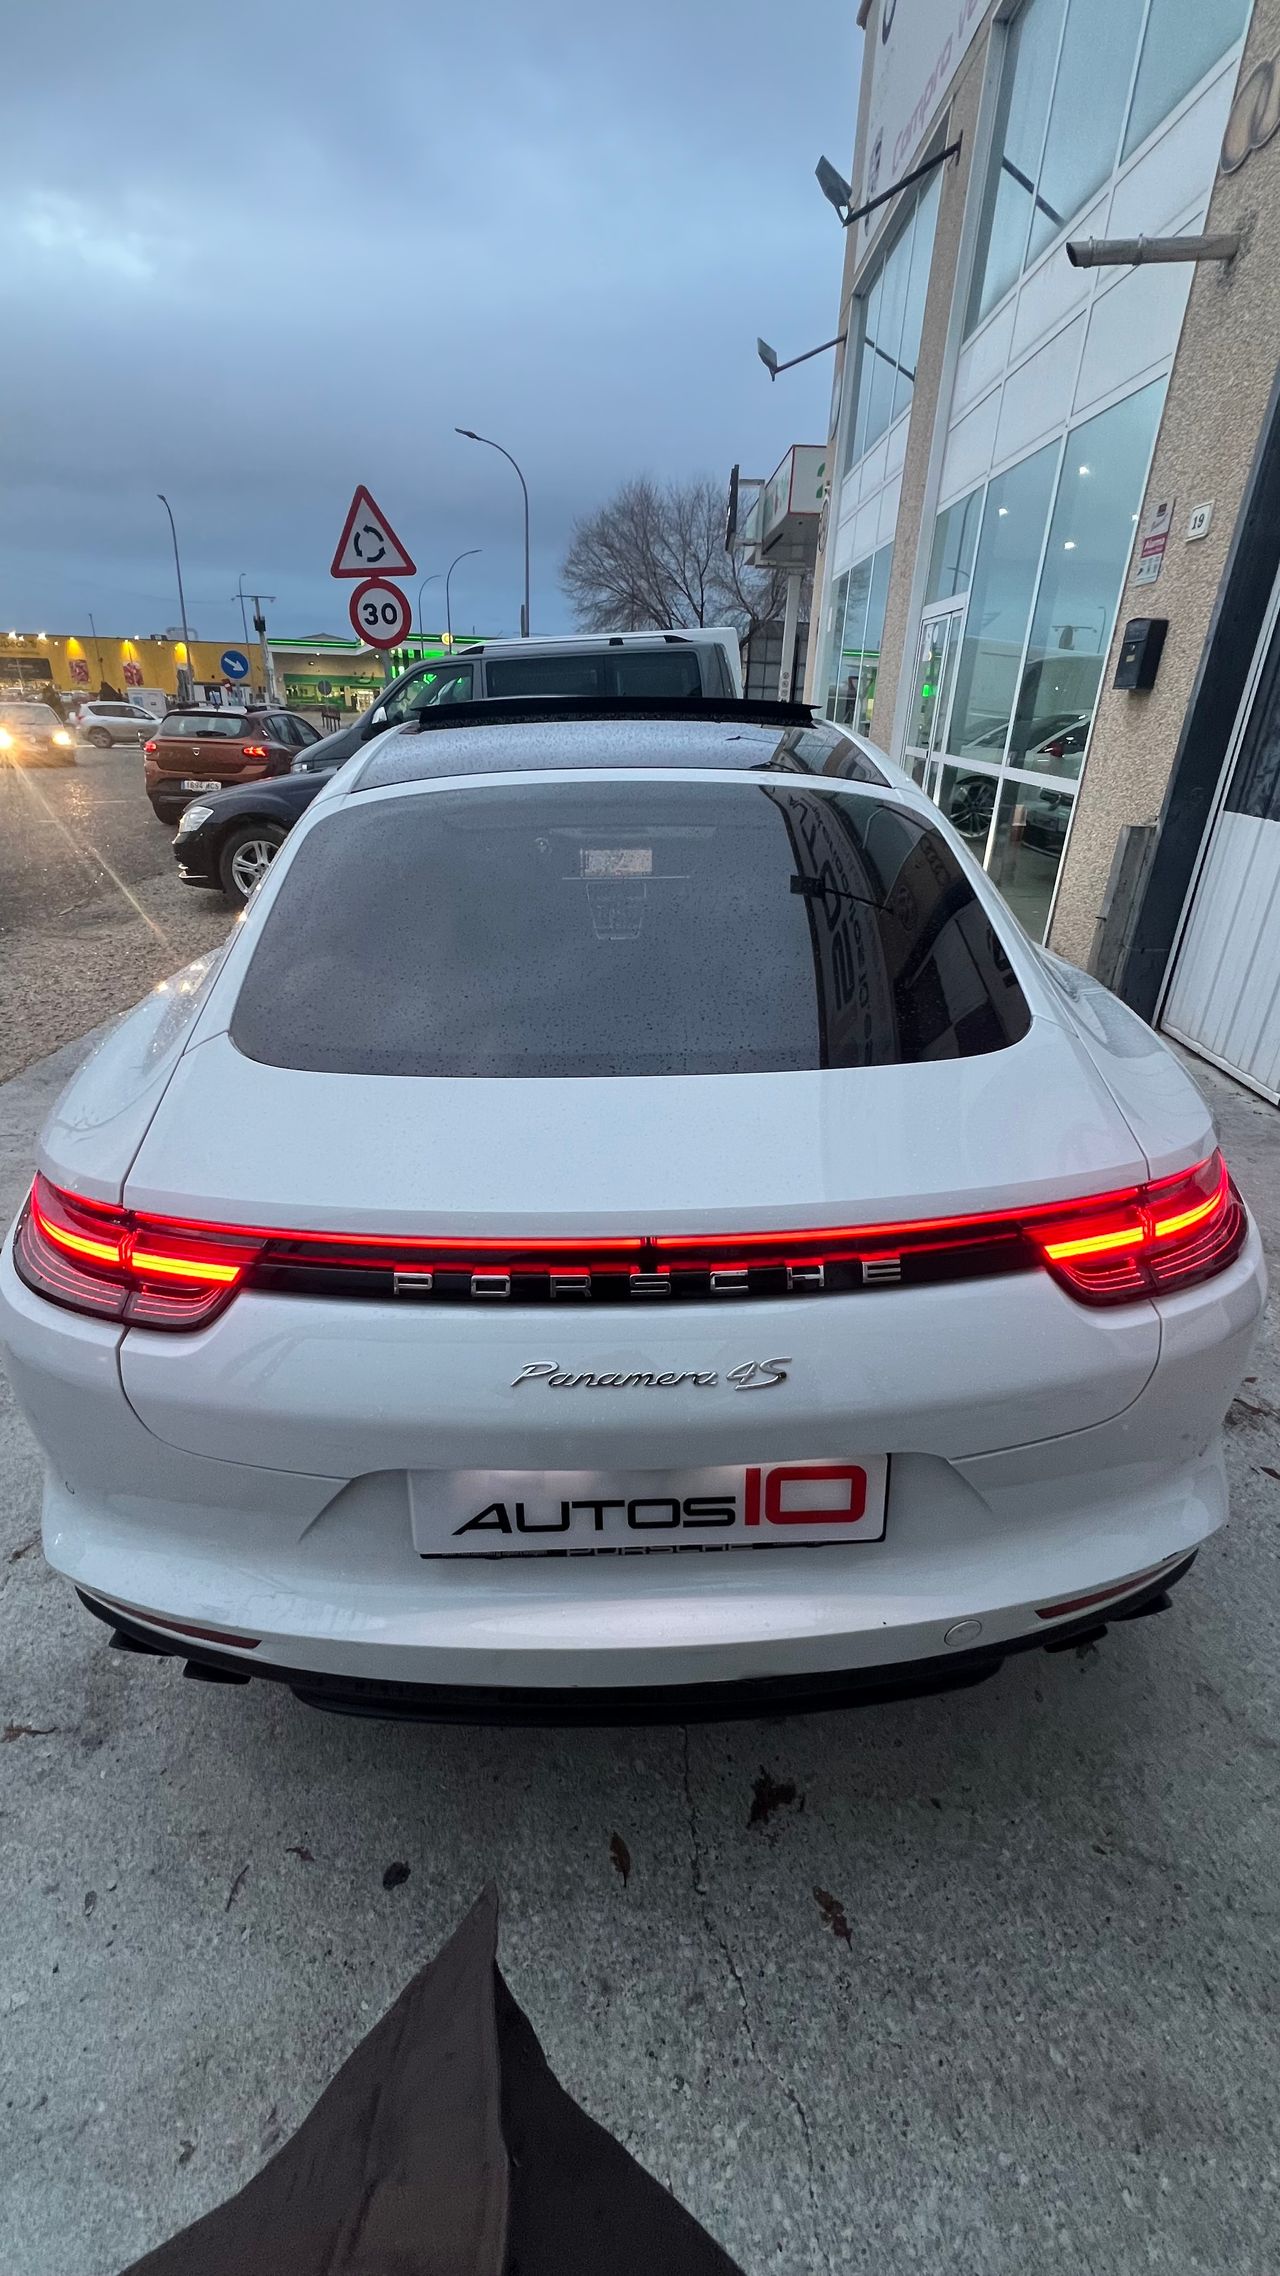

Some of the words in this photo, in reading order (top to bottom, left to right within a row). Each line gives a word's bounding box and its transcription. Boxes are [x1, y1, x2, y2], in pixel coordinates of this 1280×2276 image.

[1192, 513, 1205, 529] 19
[363, 603, 398, 627] 30
[393, 1258, 902, 1298] PORSCHE
[510, 1359, 719, 1388] Panamera
[725, 1355, 793, 1391] 4S
